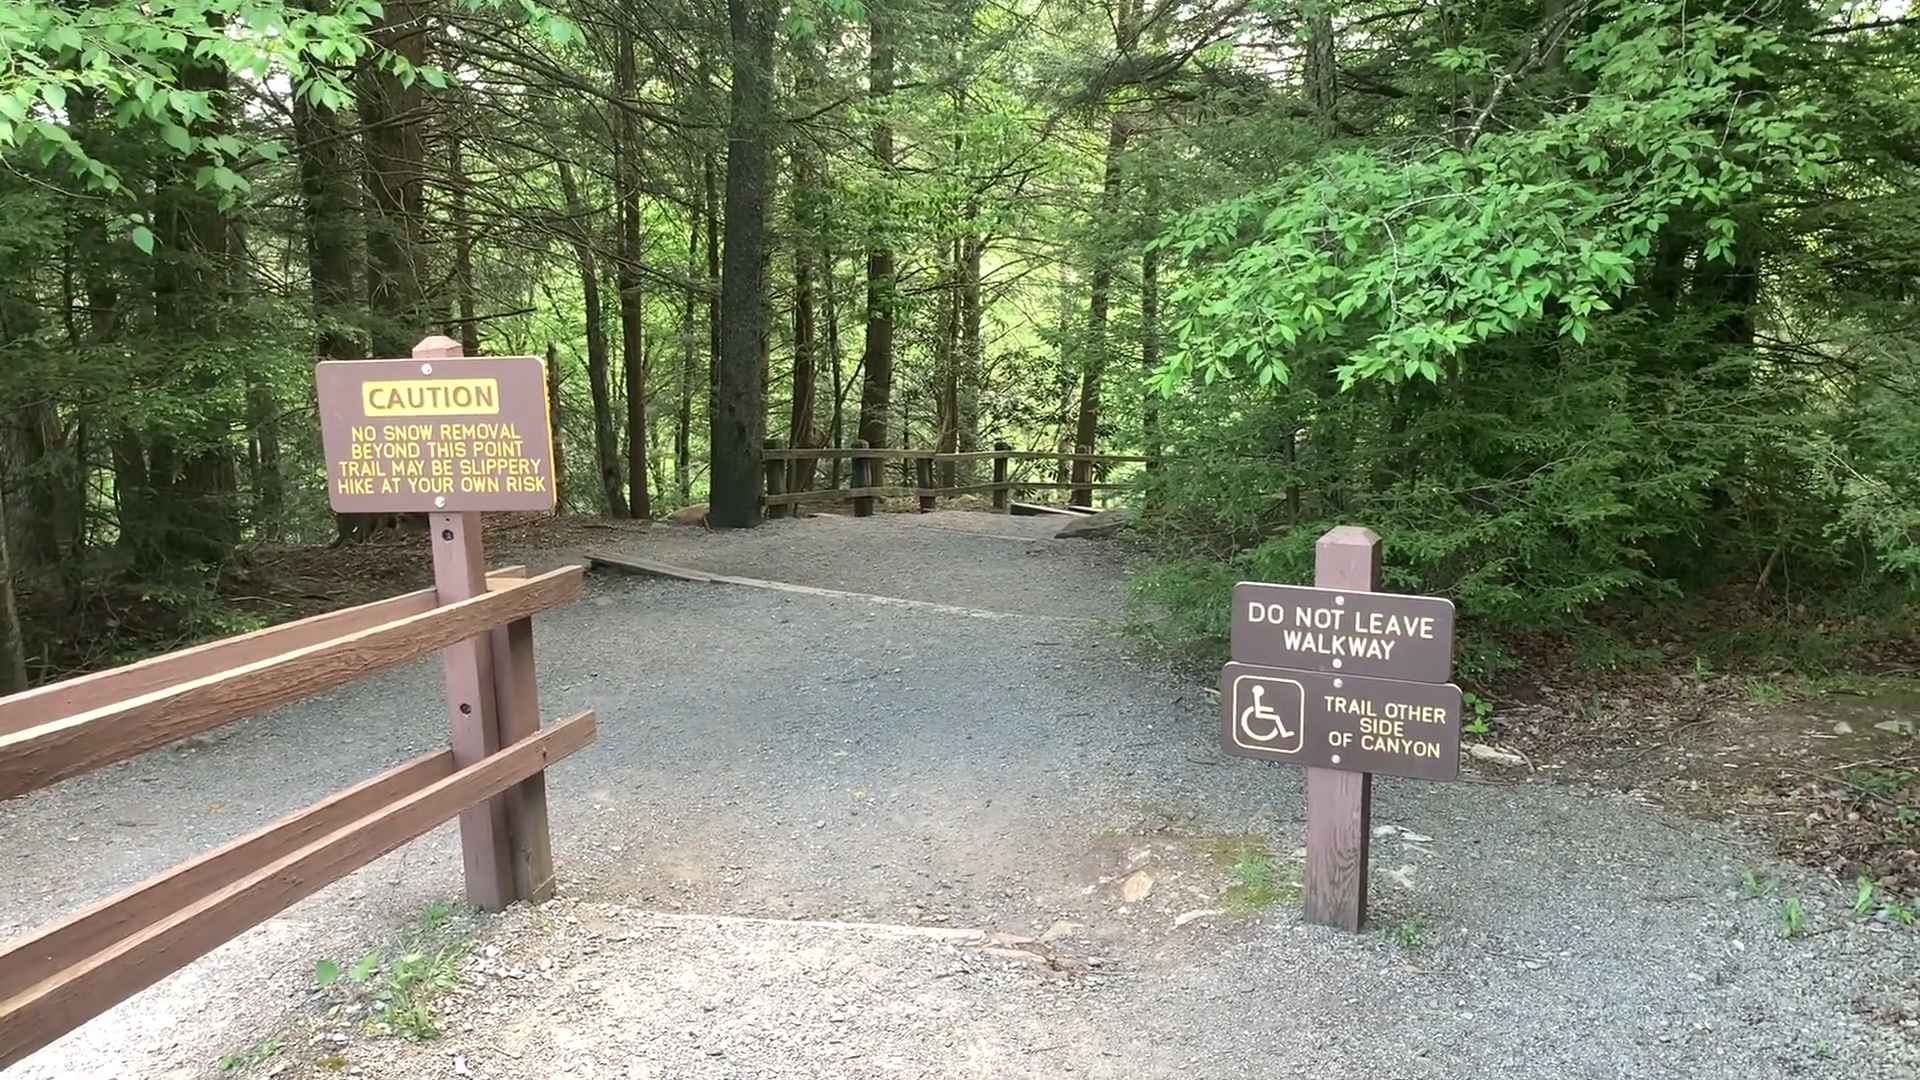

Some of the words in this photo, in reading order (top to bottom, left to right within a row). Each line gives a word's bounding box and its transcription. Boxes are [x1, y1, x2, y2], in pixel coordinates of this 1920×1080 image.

[368, 385, 493, 410] CAUTION
[351, 426, 376, 442] NO
[384, 424, 433, 441] SNOW
[440, 423, 521, 440] REMOVAL
[351, 443, 420, 459] BEYOND
[427, 442, 466, 458] THIS
[473, 440, 523, 457] POINT
[339, 461, 386, 477] TRAIL
[392, 460, 424, 476] MAY
[432, 460, 453, 475] BE
[460, 459, 541, 475] SLIPPERY
[338, 480, 375, 494] HIKE
[381, 478, 400, 494] AT
[408, 478, 454, 494] YOUR
[460, 477, 500, 493] OWN
[507, 476, 546, 492] RISK
[1248, 602, 1284, 624] DO
[1296, 607, 1344, 629] NOT
[1355, 611, 1434, 639] LEAVE
[1283, 630, 1395, 660] WALKWAY
[1324, 696, 1377, 717] TRAIL
[1385, 703, 1446, 724] OTHER
[1359, 718, 1404, 737] SIDE
[1329, 731, 1353, 747] OF
[1361, 735, 1440, 758] CANYON
